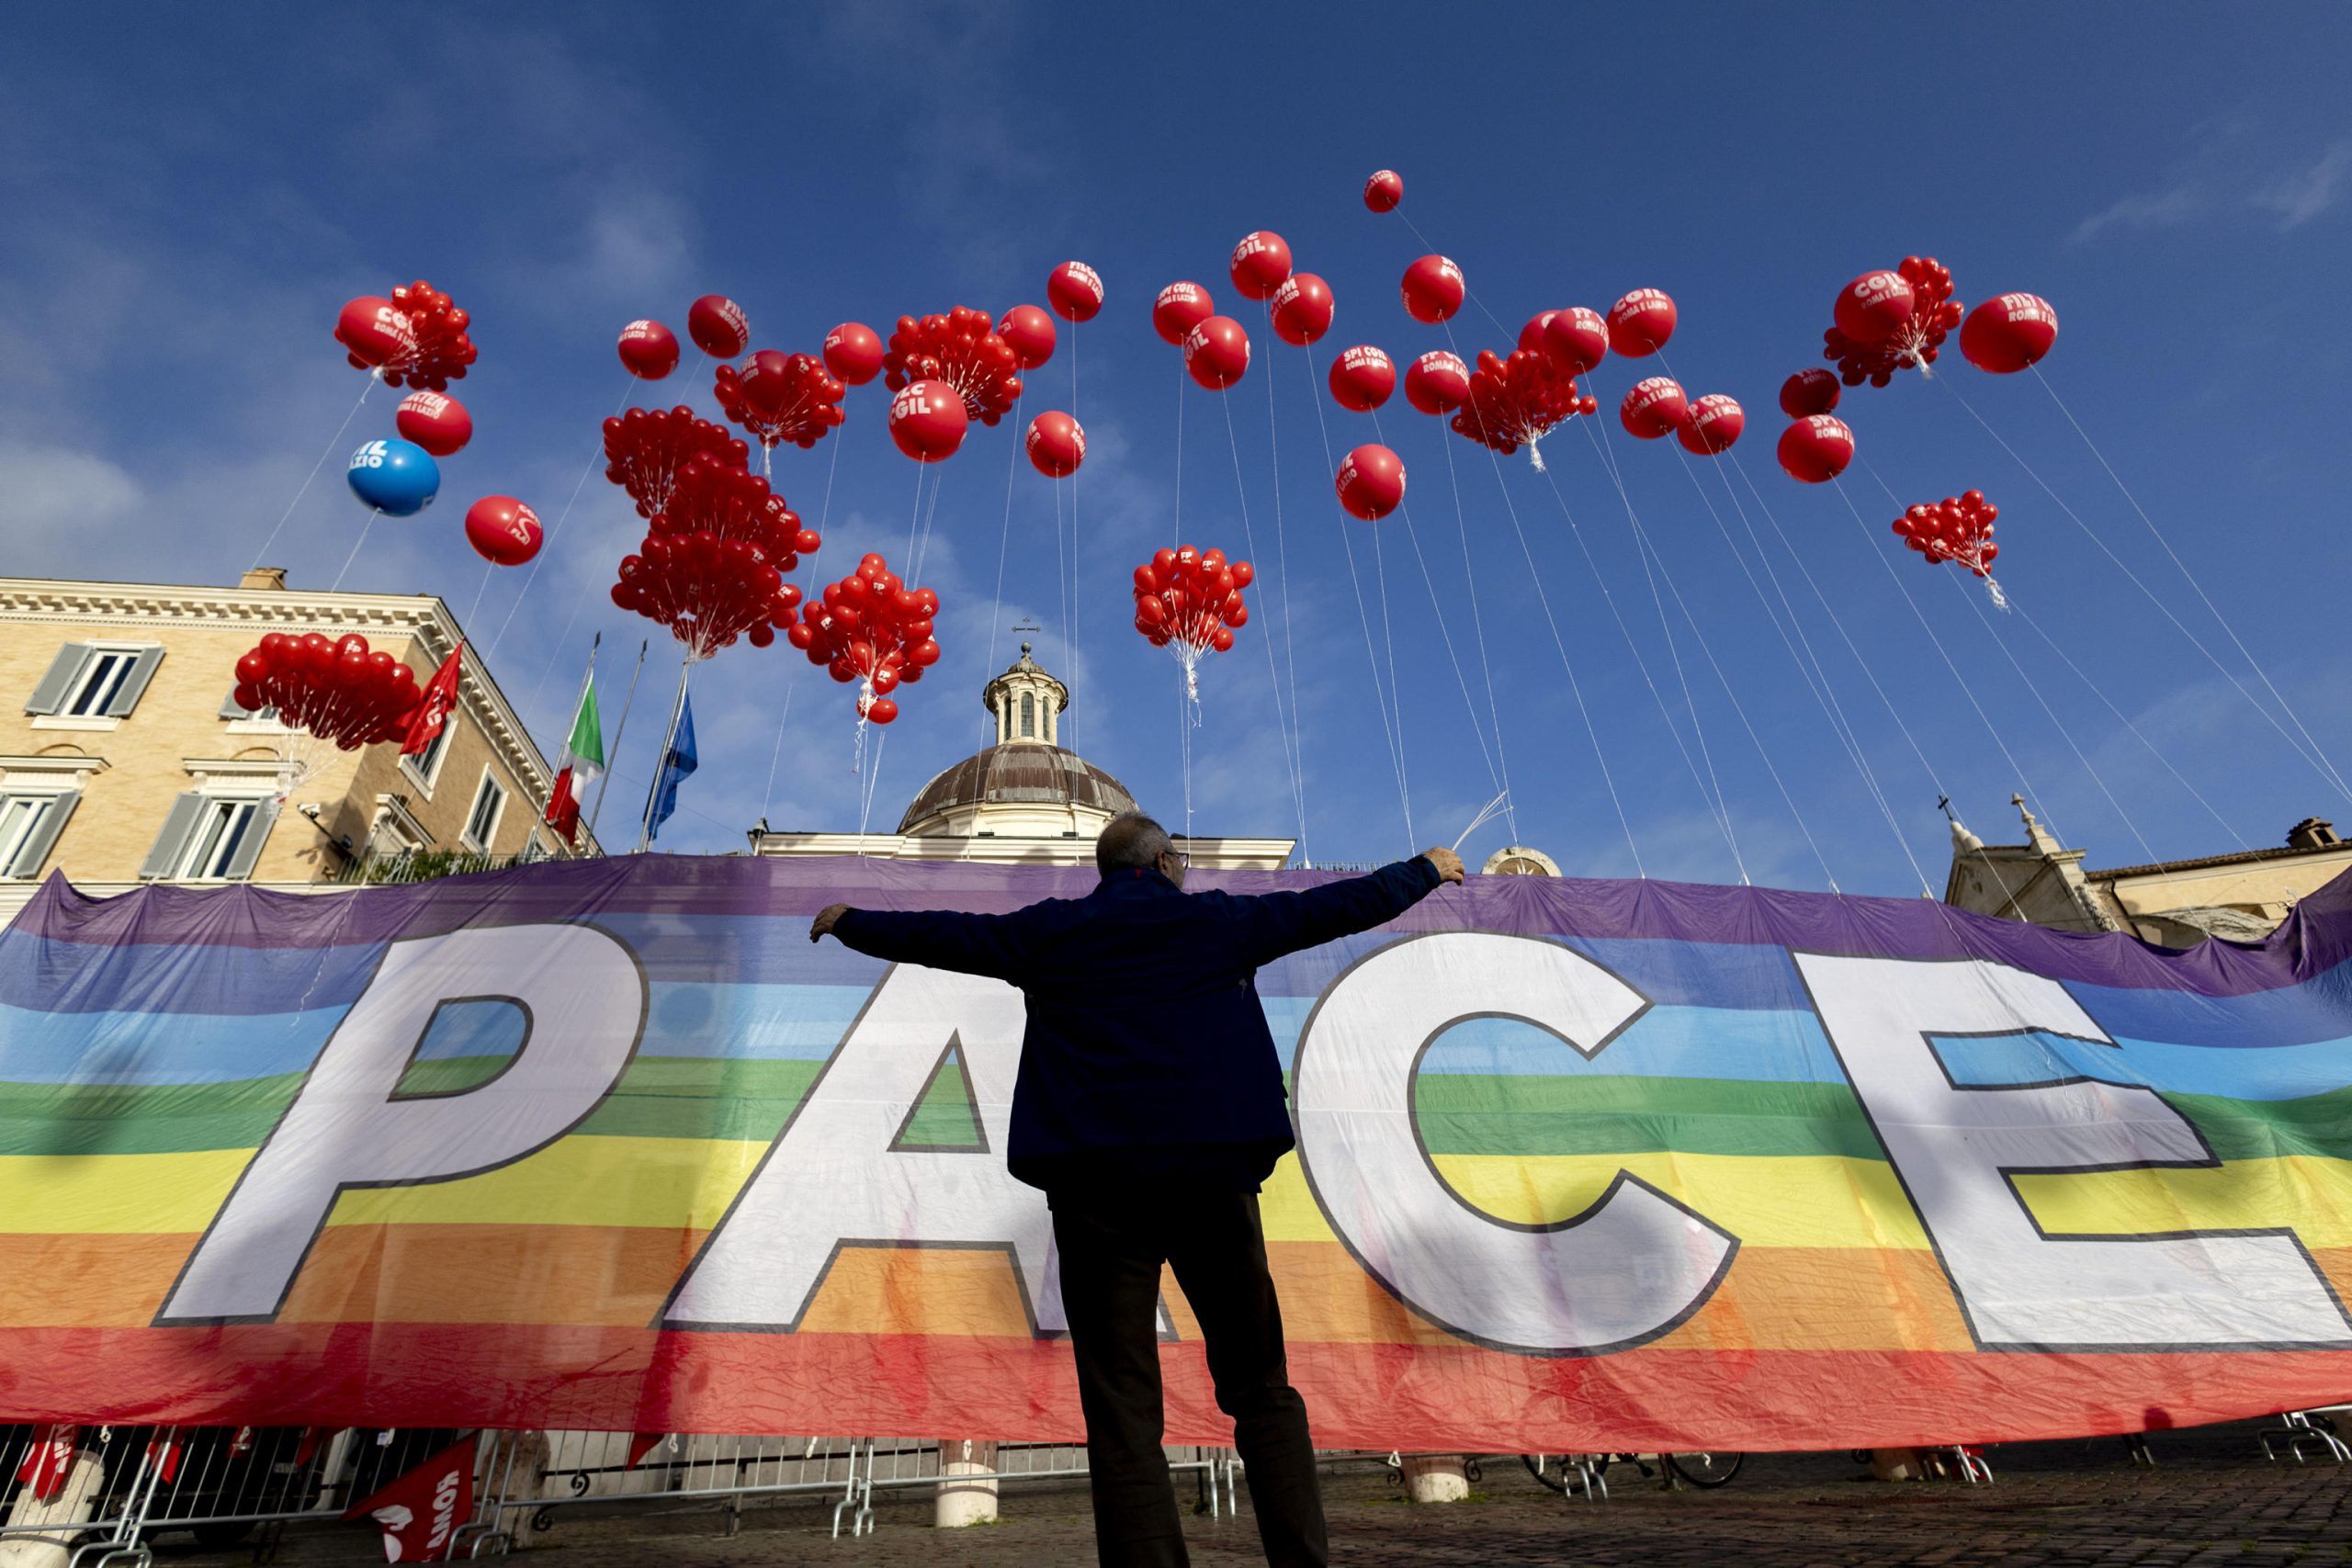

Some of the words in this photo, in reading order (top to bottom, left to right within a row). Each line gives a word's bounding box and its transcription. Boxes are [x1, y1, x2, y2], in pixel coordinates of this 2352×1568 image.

[1232, 239, 1266, 271] CGIL
[1173, 283, 1196, 295] CGIL
[1854, 273, 1906, 298] CGIL
[1281, 289, 1301, 305] LAZIO
[1613, 288, 1667, 313] CGIL
[719, 310, 740, 330] ROMA
[1617, 304, 1640, 325] ROMA
[2008, 309, 2040, 323] ROMA
[373, 321, 398, 340] ROMA
[1575, 320, 1600, 333] ROMA
[1343, 347, 1363, 362] SPI
[1363, 346, 1388, 361] CGIL
[1345, 358, 1365, 372] ROMA
[1423, 360, 1448, 374] ROMA
[1636, 376, 1676, 393] CGIL
[1631, 397, 1651, 419] ROMA
[1699, 393, 1739, 407] CGIL
[416, 404, 441, 420] LAZIO
[889, 398, 931, 426] CGIL
[1815, 427, 1843, 439] ROMA
[1338, 468, 1358, 492] LAZIO
[151, 921, 2352, 1358] PACE
[425, 1470, 459, 1550] ROMA
